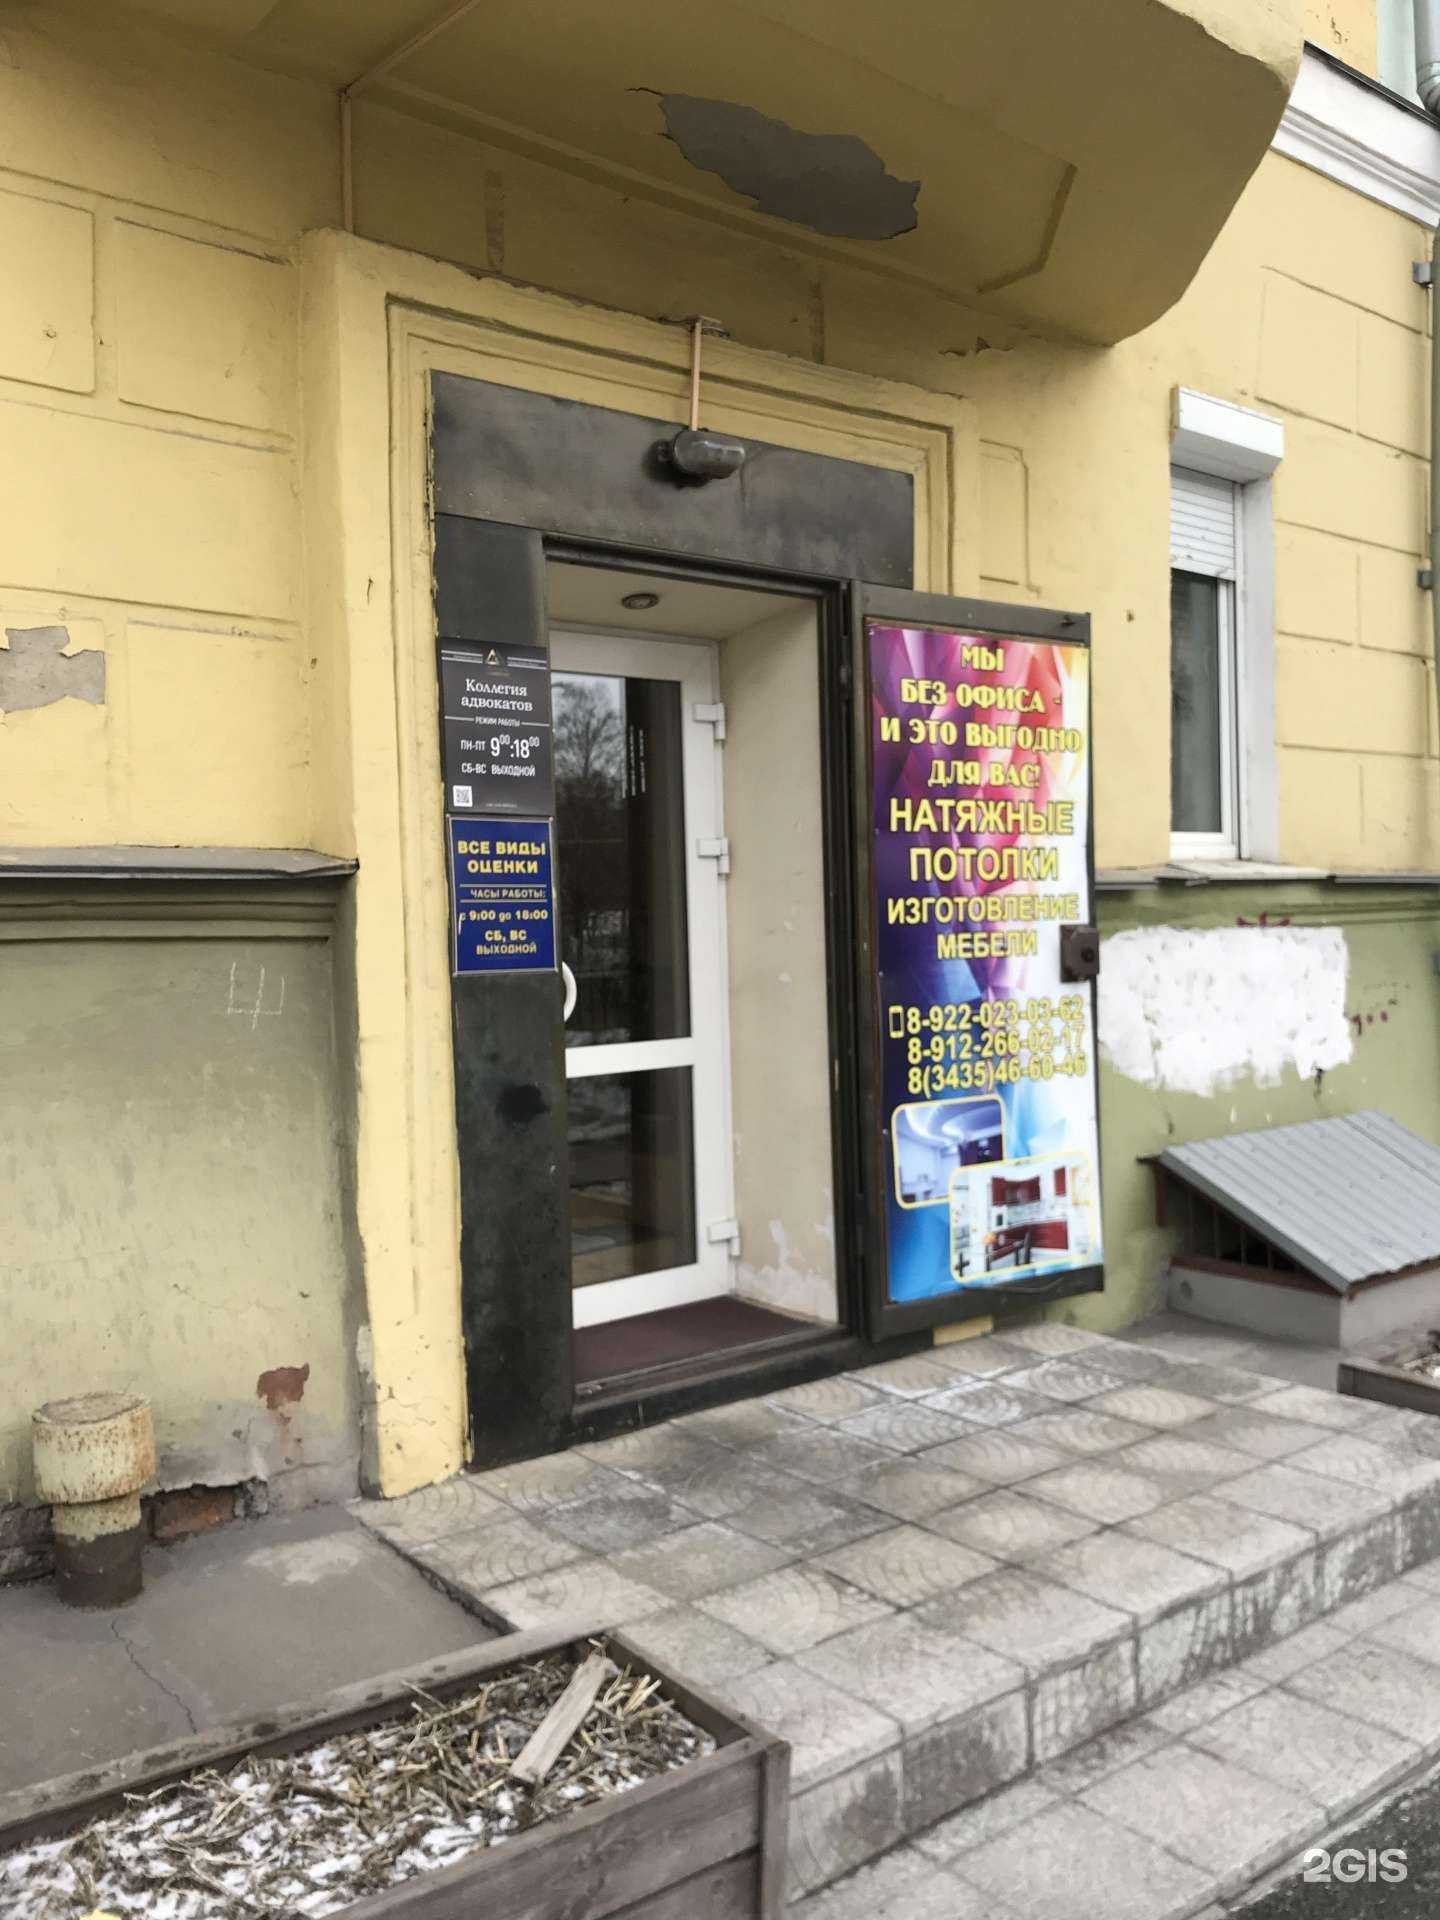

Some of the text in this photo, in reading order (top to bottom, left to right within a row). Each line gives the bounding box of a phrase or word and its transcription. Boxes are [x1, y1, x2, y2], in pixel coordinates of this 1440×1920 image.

[961, 645, 1005, 672] МЫ
[465, 679, 528, 697] Коллегия
[900, 678, 948, 705] БЕЗ
[955, 683, 1047, 713] ОФИСА
[461, 696, 533, 712] адвокатов
[475, 716, 521, 727] РЕЖИМ РАБОТЫ
[880, 716, 1083, 754] И ЭТО ВЫГОДНО
[460, 739, 486, 751] ПН-ПТ
[461, 763, 536, 777] СБ-ВС ВЫХОДНОЙ
[928, 759, 1041, 788] ДЛЯ ВАС!
[889, 798, 1074, 835] НАТЯЖНЫЕ
[457, 840, 546, 856] ВСЕ ВИДЫ
[467, 860, 538, 874] ОЦЕНКИ
[909, 847, 1059, 882] ПОТОЛКИ
[470, 889, 546, 898] ЧАСЫ РАБОТЫ:
[469, 910, 496, 921] 9:00
[515, 910, 548, 921] 18:00
[887, 893, 1080, 925] ИЗГОТОВЛЕНИЕ
[510, 930, 527, 941] ВС
[476, 942, 537, 955] ВЫХОДНОЙ
[937, 930, 1038, 960] МЕБЕЛИ
